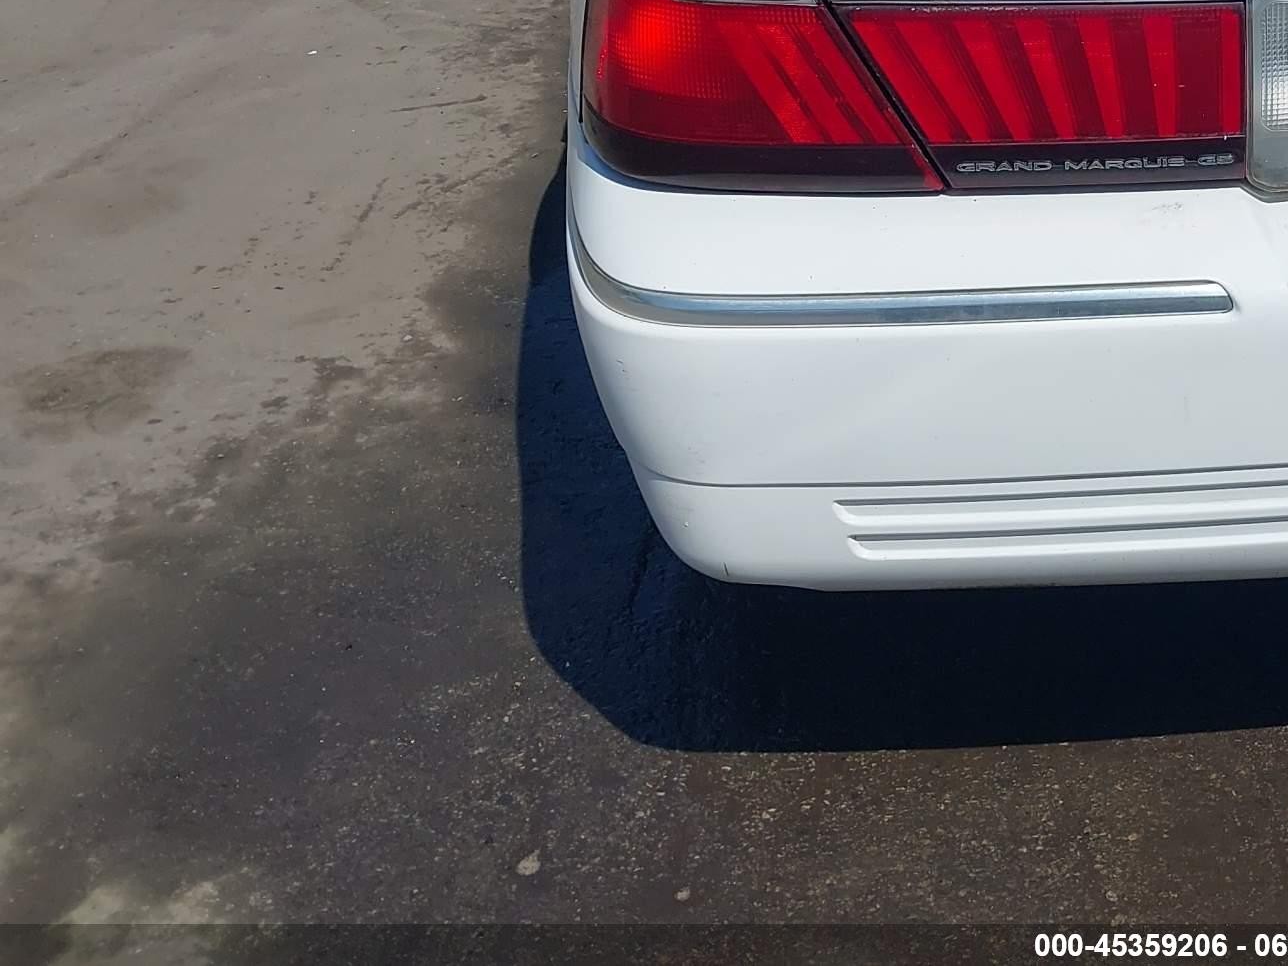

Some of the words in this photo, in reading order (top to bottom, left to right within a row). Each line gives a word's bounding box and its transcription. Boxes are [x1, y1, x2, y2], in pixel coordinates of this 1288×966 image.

[955, 160, 1053, 173] GRAND
[1064, 155, 1186, 171] MARQUIS
[1197, 152, 1236, 166] GS
